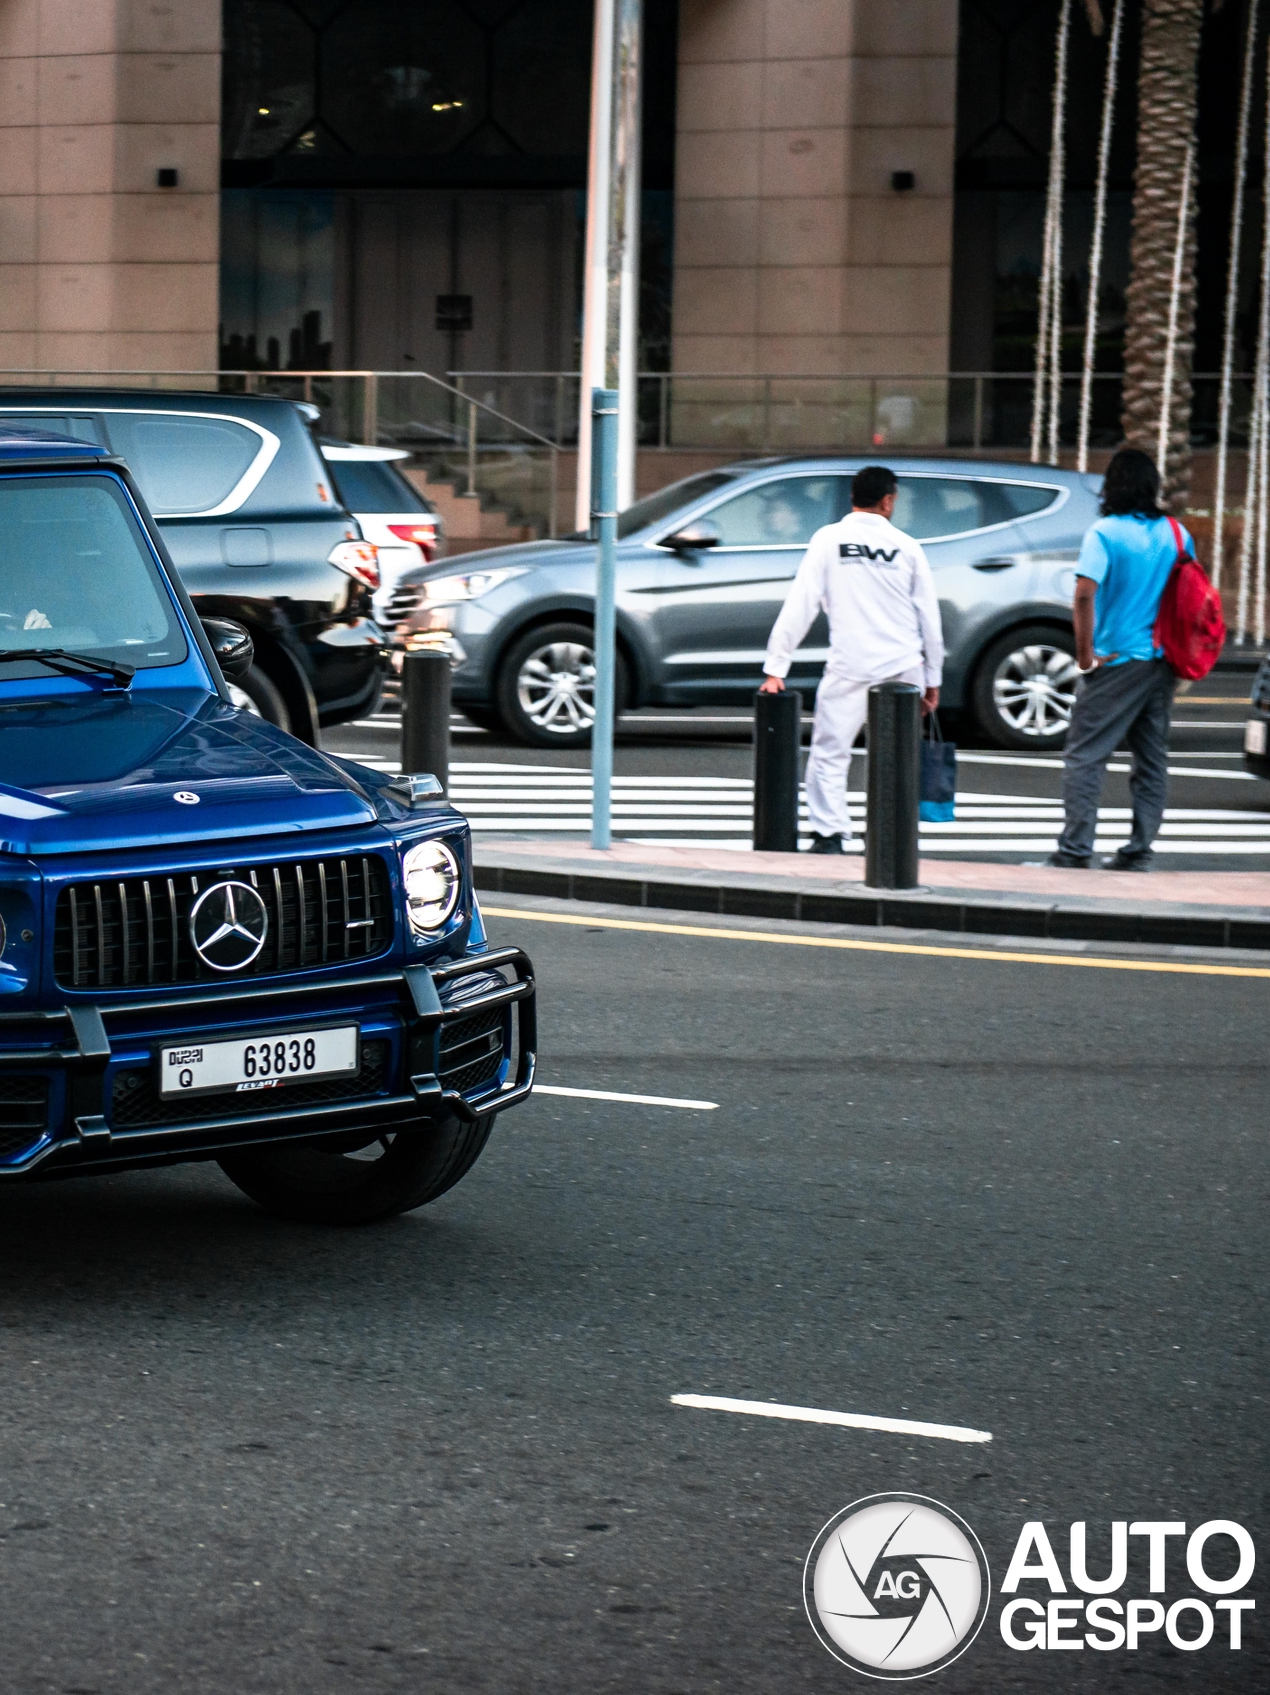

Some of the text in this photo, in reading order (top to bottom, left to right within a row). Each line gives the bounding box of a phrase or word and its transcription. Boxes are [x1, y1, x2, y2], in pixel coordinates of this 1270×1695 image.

[839, 543, 899, 562] BW
[244, 1038, 316, 1077] 63838
[179, 1068, 193, 1088] Q
